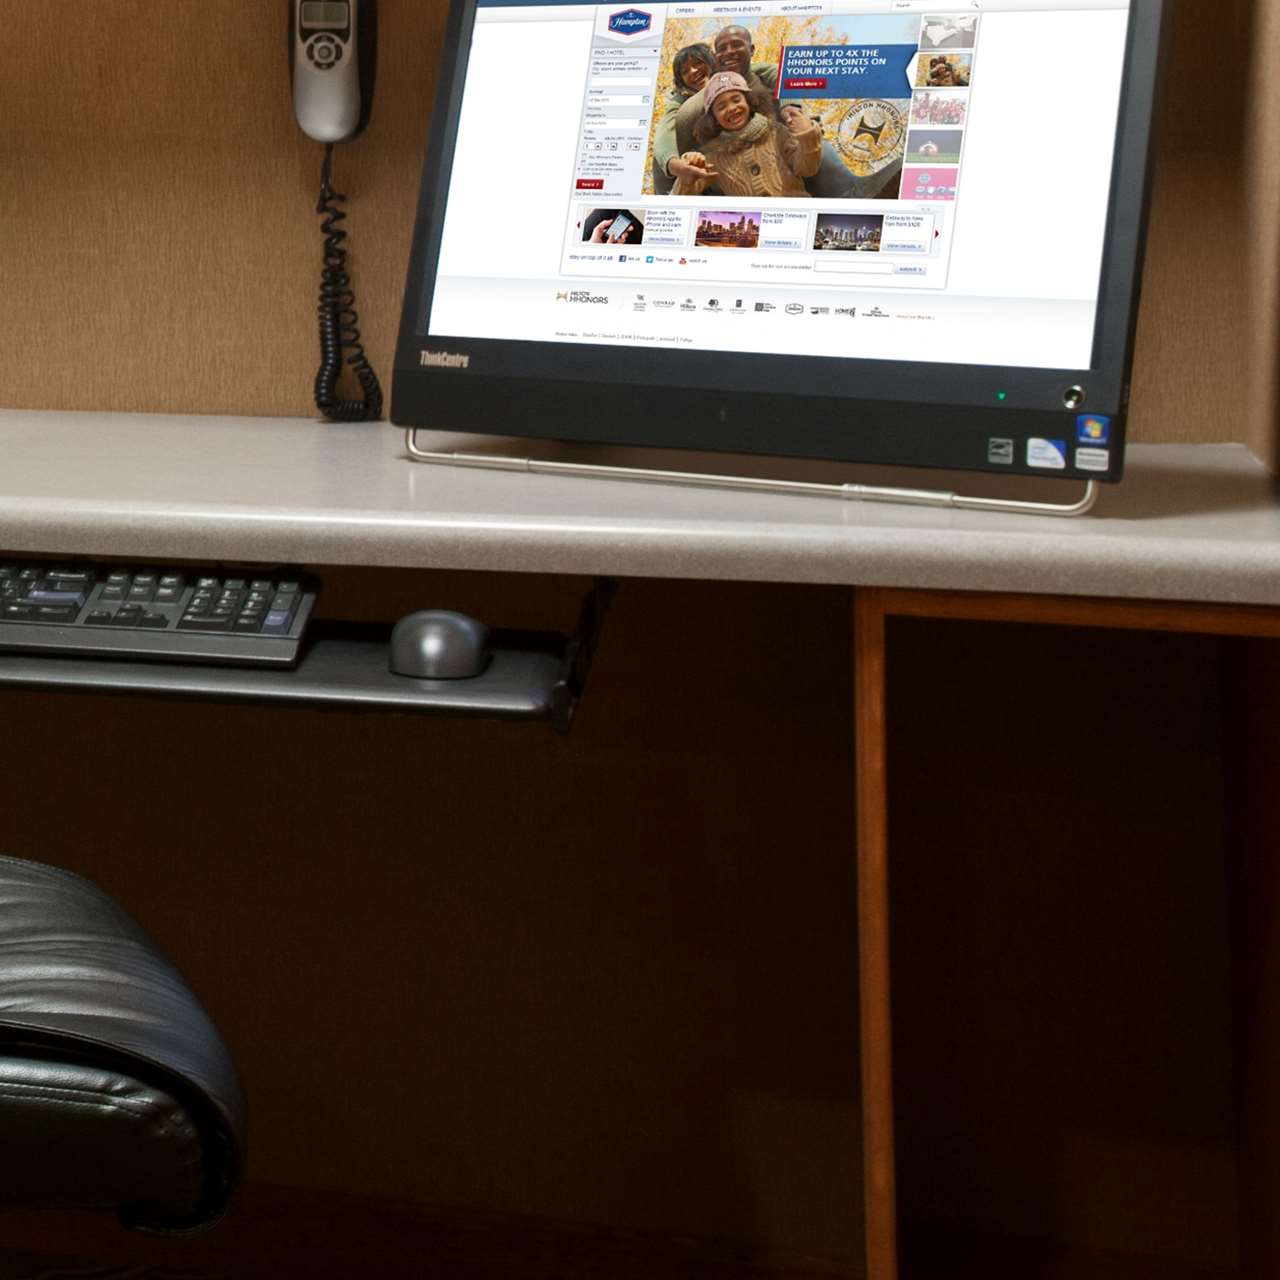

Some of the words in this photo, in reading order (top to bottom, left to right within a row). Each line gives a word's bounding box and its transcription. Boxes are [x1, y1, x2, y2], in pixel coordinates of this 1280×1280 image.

[788, 49, 814, 58] EARN
[815, 49, 829, 58] UP
[831, 49, 844, 57] TO
[846, 49, 858, 57] 4X
[861, 49, 879, 57] THE
[787, 58, 833, 66] HHONORS
[835, 58, 869, 66] POINTS
[786, 67, 813, 75] YOUR
[815, 67, 840, 75] NEXT
[841, 66, 869, 75] STAY.
